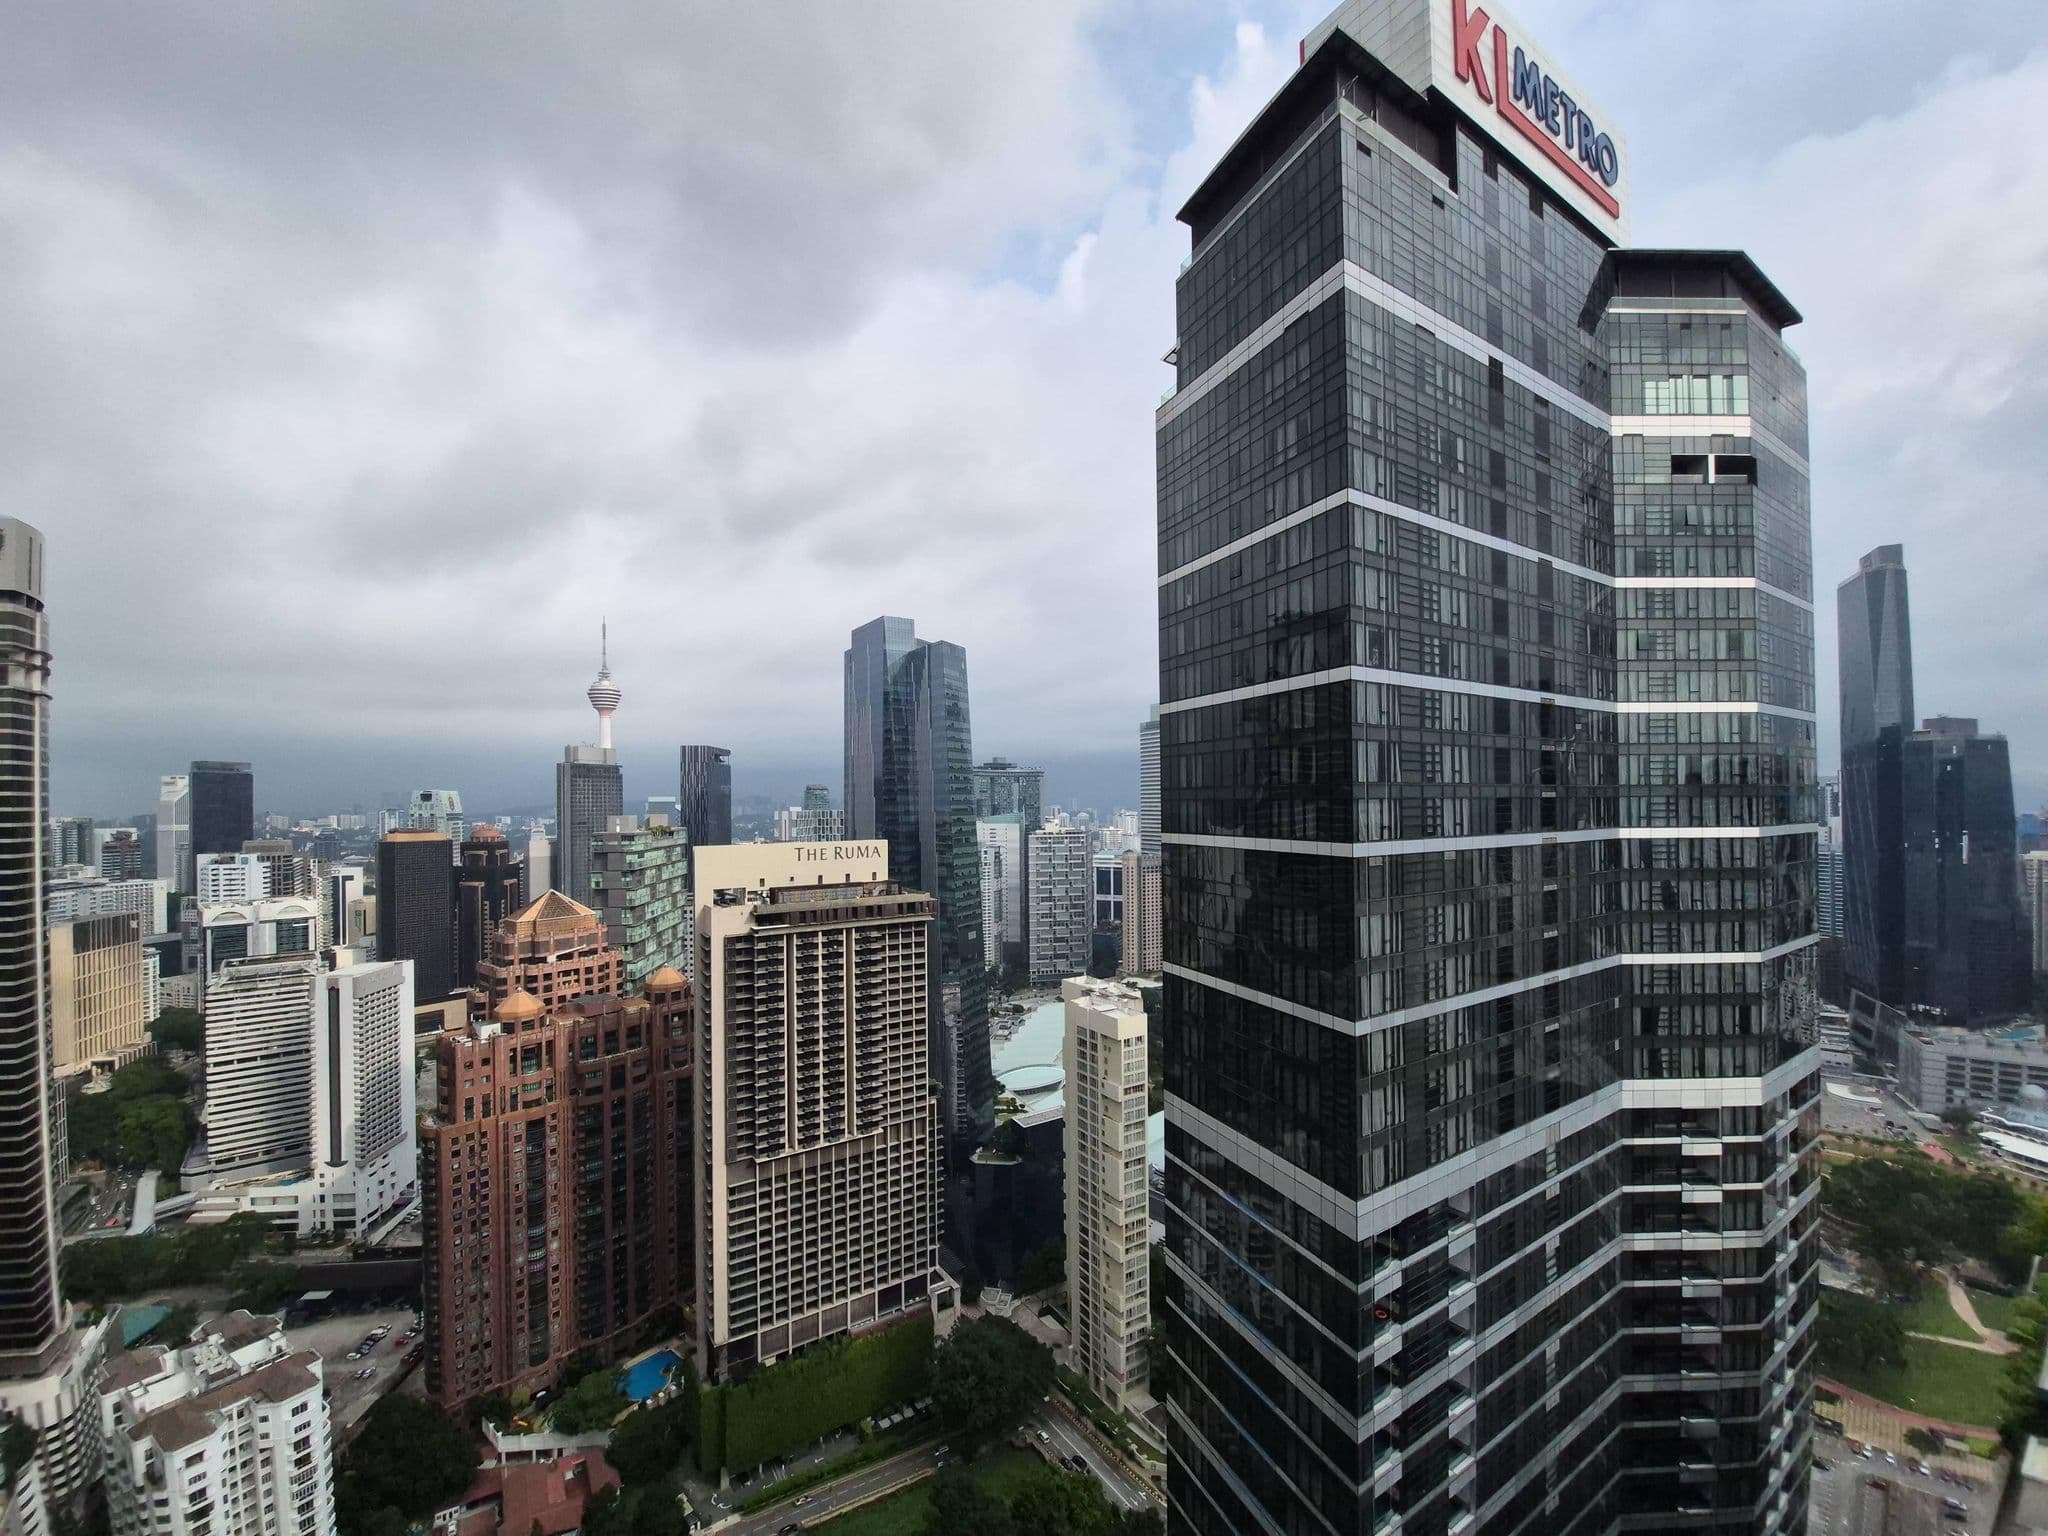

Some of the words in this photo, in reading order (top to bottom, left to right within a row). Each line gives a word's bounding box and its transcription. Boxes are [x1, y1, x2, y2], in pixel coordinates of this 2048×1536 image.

[1513, 46, 1619, 187] METRO
[794, 847, 828, 862] THE
[834, 845, 881, 860] RUMA
